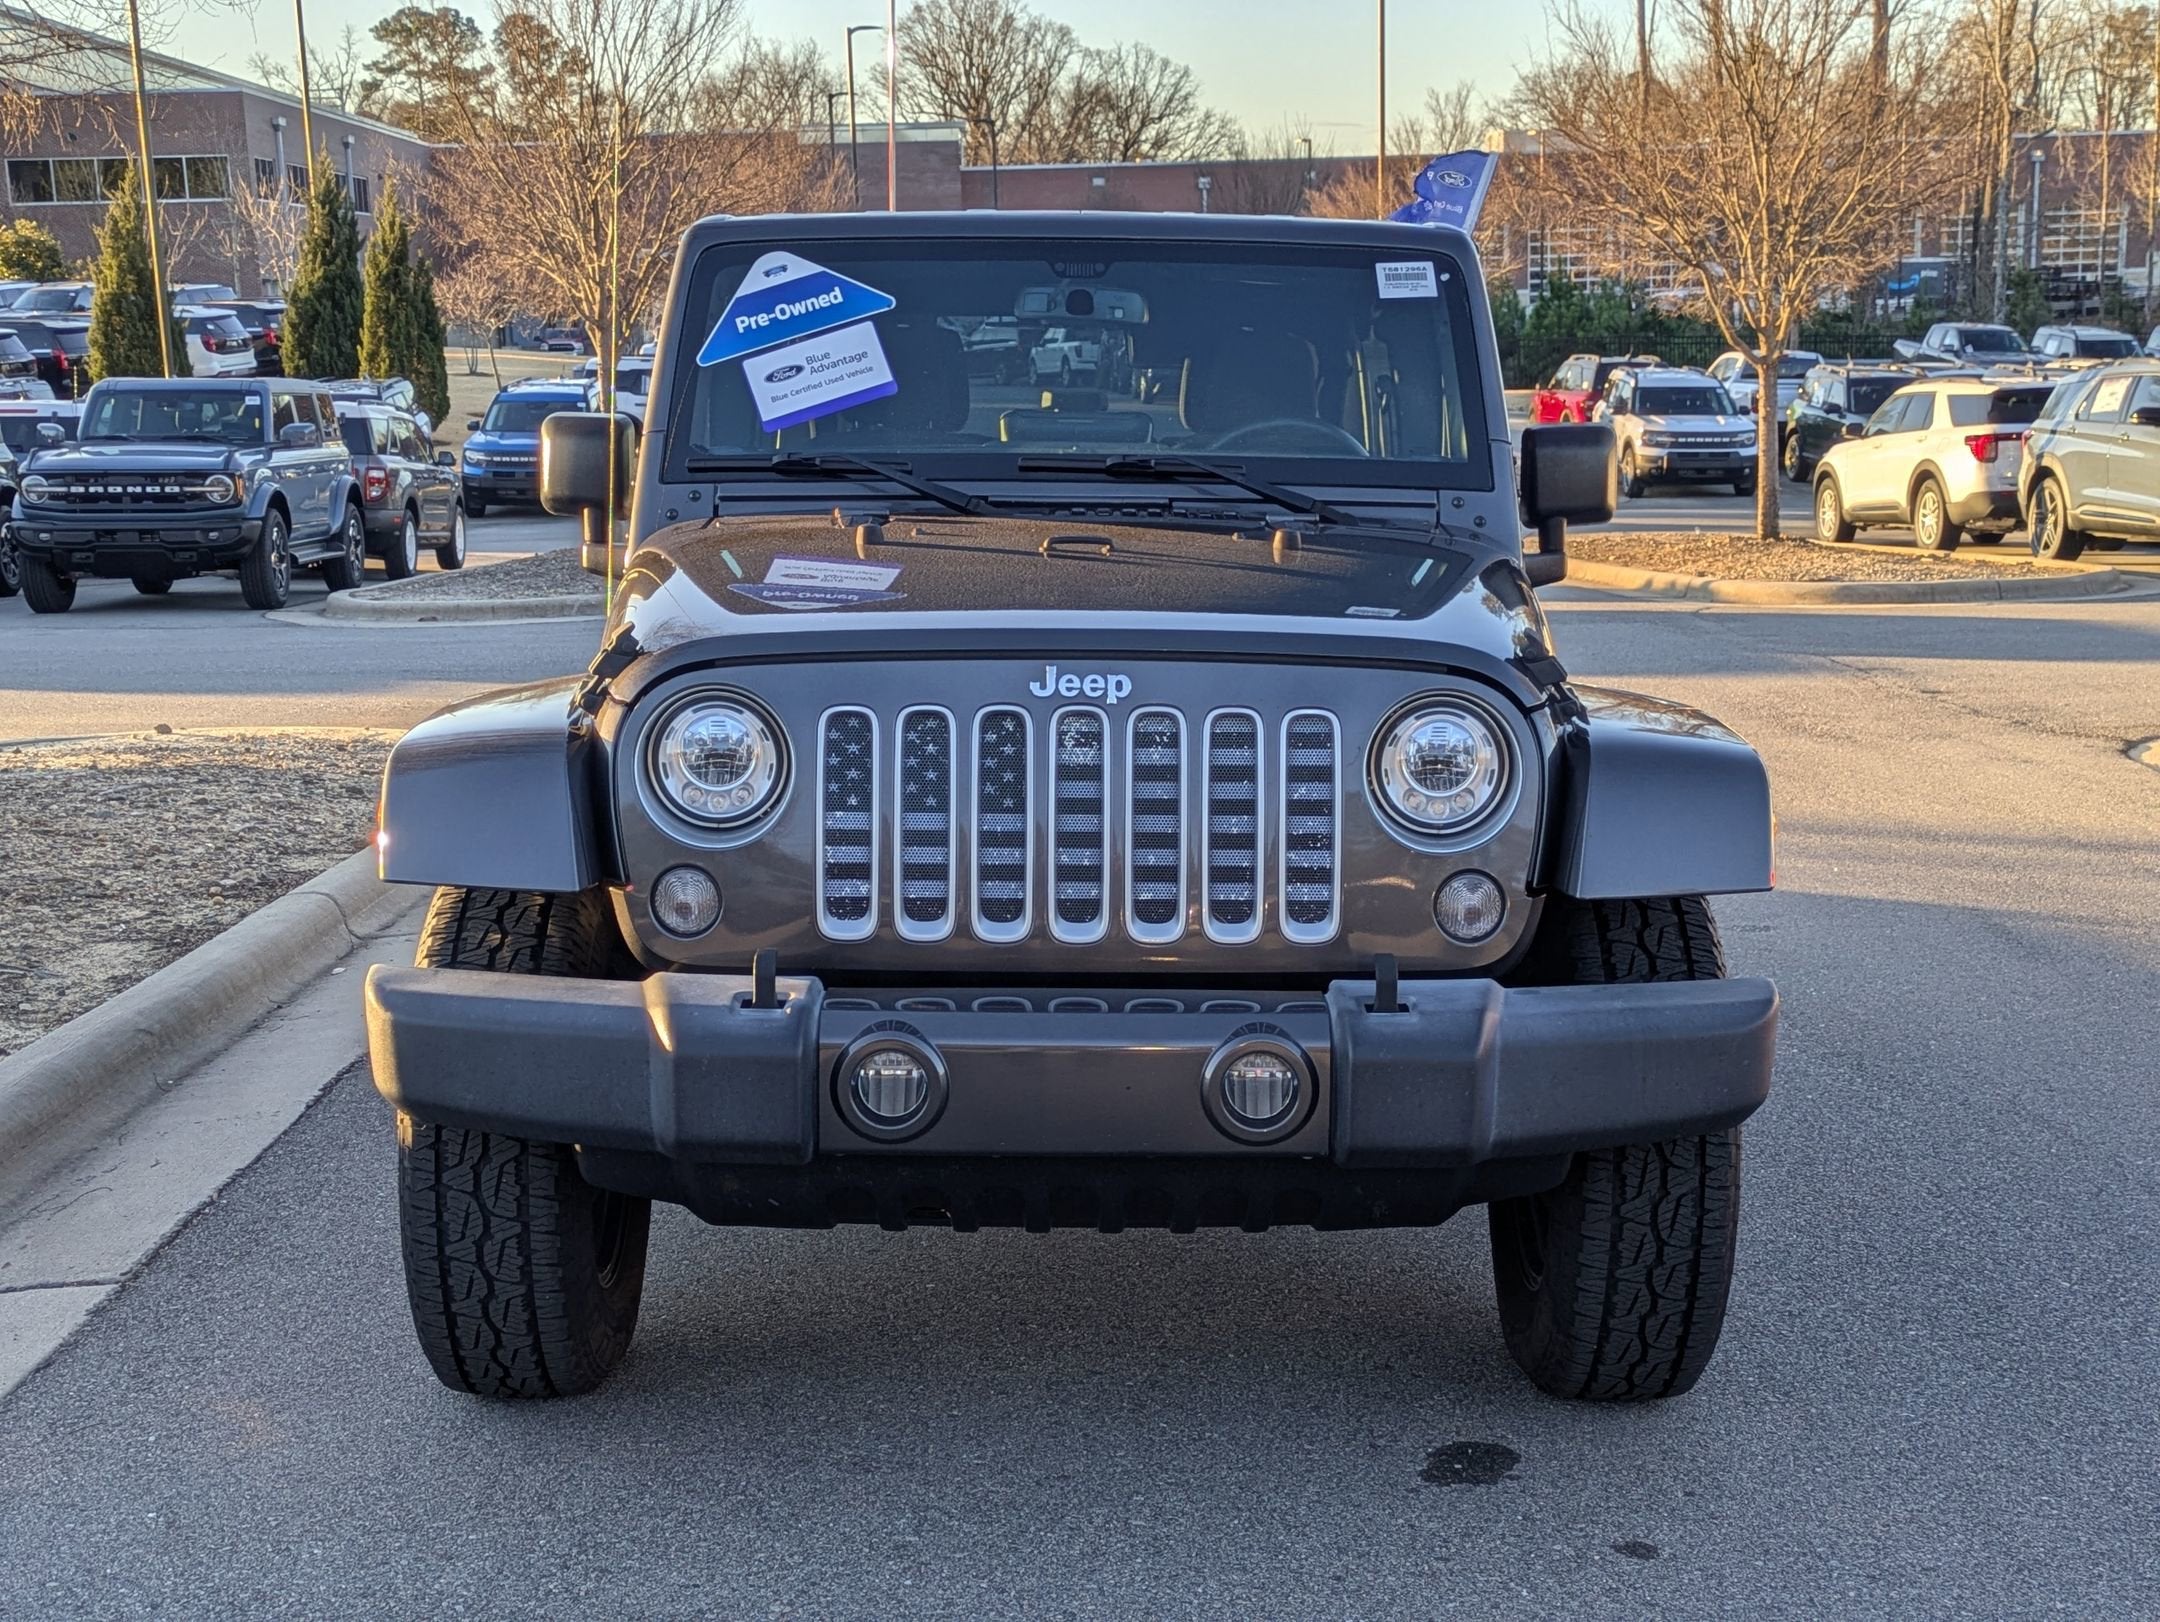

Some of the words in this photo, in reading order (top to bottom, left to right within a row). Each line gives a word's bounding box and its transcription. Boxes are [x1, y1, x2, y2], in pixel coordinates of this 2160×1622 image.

[735, 286, 844, 334] Pre-Owned
[805, 352, 831, 365] Blue
[809, 350, 869, 375] Advantage
[770, 393, 789, 403] Blue
[790, 382, 823, 397] Certified
[824, 374, 845, 385] Used
[845, 366, 874, 379] Vehicle
[69, 485, 181, 493] BRONCO
[1029, 665, 1132, 704] Jeep
